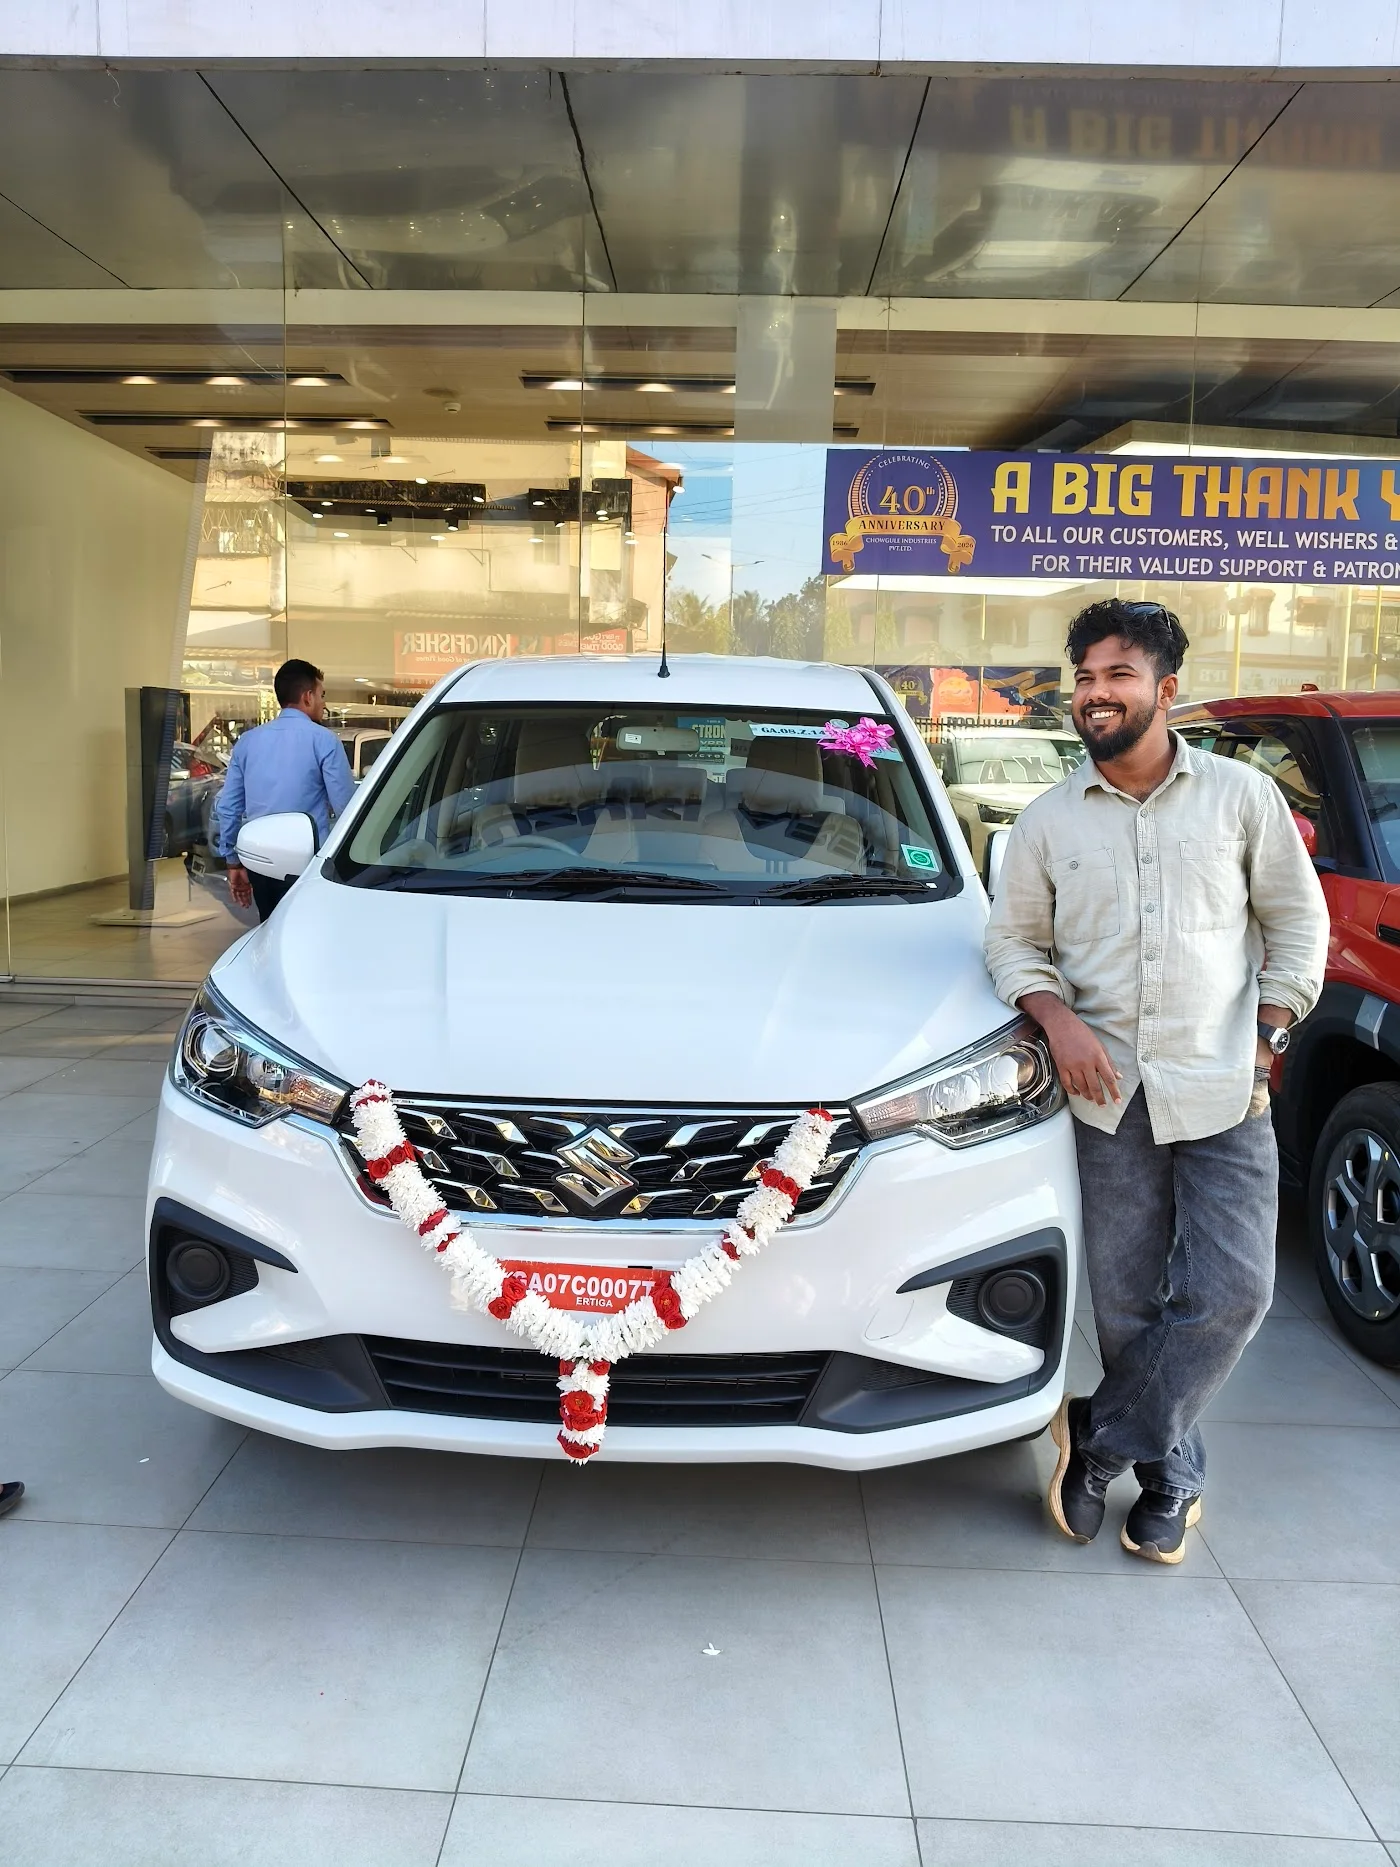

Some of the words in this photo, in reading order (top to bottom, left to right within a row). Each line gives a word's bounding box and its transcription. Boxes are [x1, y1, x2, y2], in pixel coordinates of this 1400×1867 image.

[878, 455, 931, 470] CELEBRATING
[879, 485, 935, 515] 40th
[991, 461, 1031, 514] A
[1052, 462, 1154, 516] BIG
[1173, 465, 1360, 521] THANK
[858, 520, 946, 531] ANNIVERSARY
[991, 525, 1017, 543] TO
[1021, 526, 1057, 544] ALL
[1063, 527, 1104, 545] OUR
[1110, 528, 1229, 550] CUSTOMERS,
[1237, 530, 1289, 548] WELL
[1295, 531, 1378, 550] WISHERS
[1384, 533, 1398, 551] &
[1031, 554, 1070, 572] FOR
[1076, 555, 1132, 574] THEIR
[1139, 557, 1213, 575] VALUED
[1219, 558, 1307, 577] SUPPORT
[1313, 560, 1326, 578] &
[576, 1296, 613, 1308] ERTIGA
